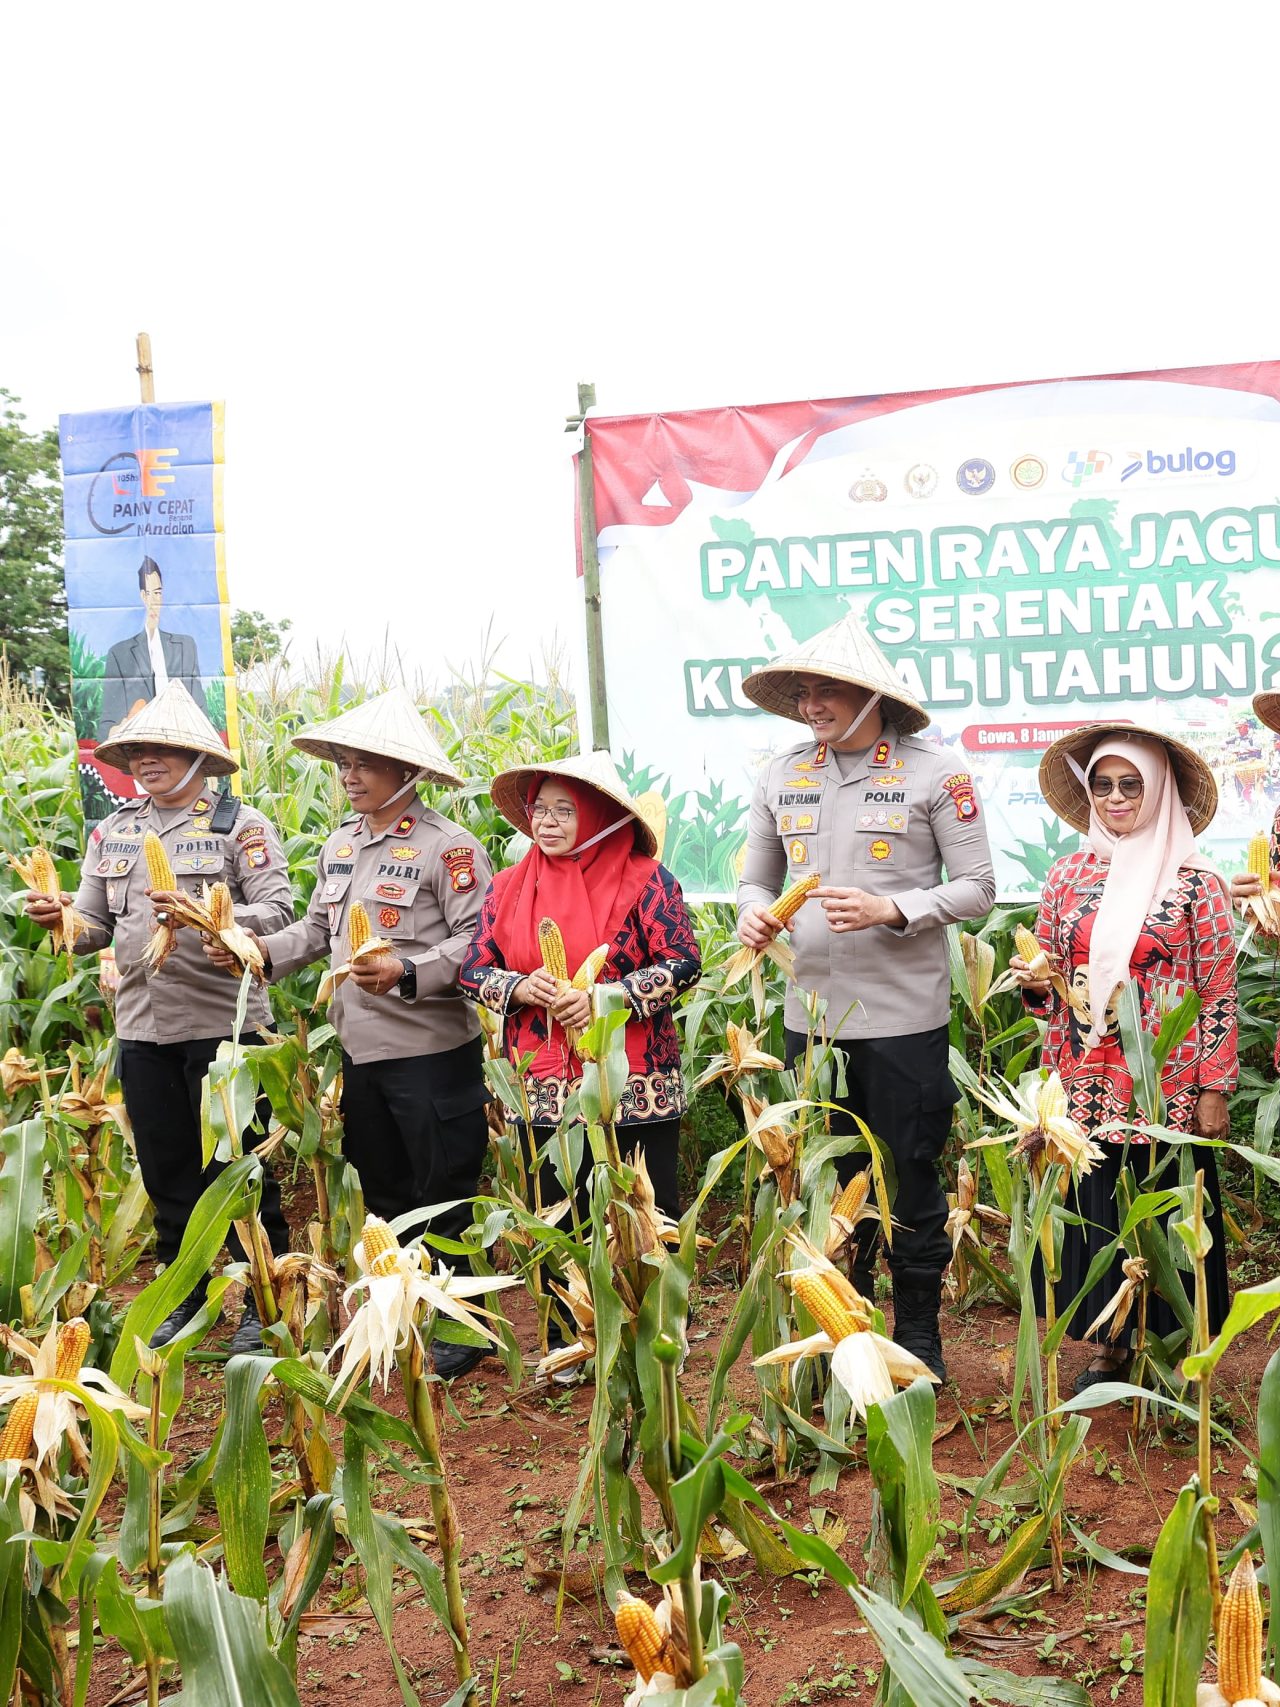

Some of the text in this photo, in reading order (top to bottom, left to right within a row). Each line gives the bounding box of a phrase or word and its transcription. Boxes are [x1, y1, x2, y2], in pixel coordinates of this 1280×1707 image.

[1147, 446, 1236, 476] bulog
[157, 499, 195, 515] CEPAT
[705, 534, 919, 594] PANEN
[938, 522, 1111, 580] RAYA
[872, 580, 1224, 644] SERENTAK
[1021, 641, 1250, 698] TAHUN
[977, 728, 1019, 745] Gowa,
[1020, 727, 1030, 743] 8
[864, 791, 906, 803] POLRI
[175, 839, 222, 854] POLRI
[377, 864, 422, 881] POLRI
